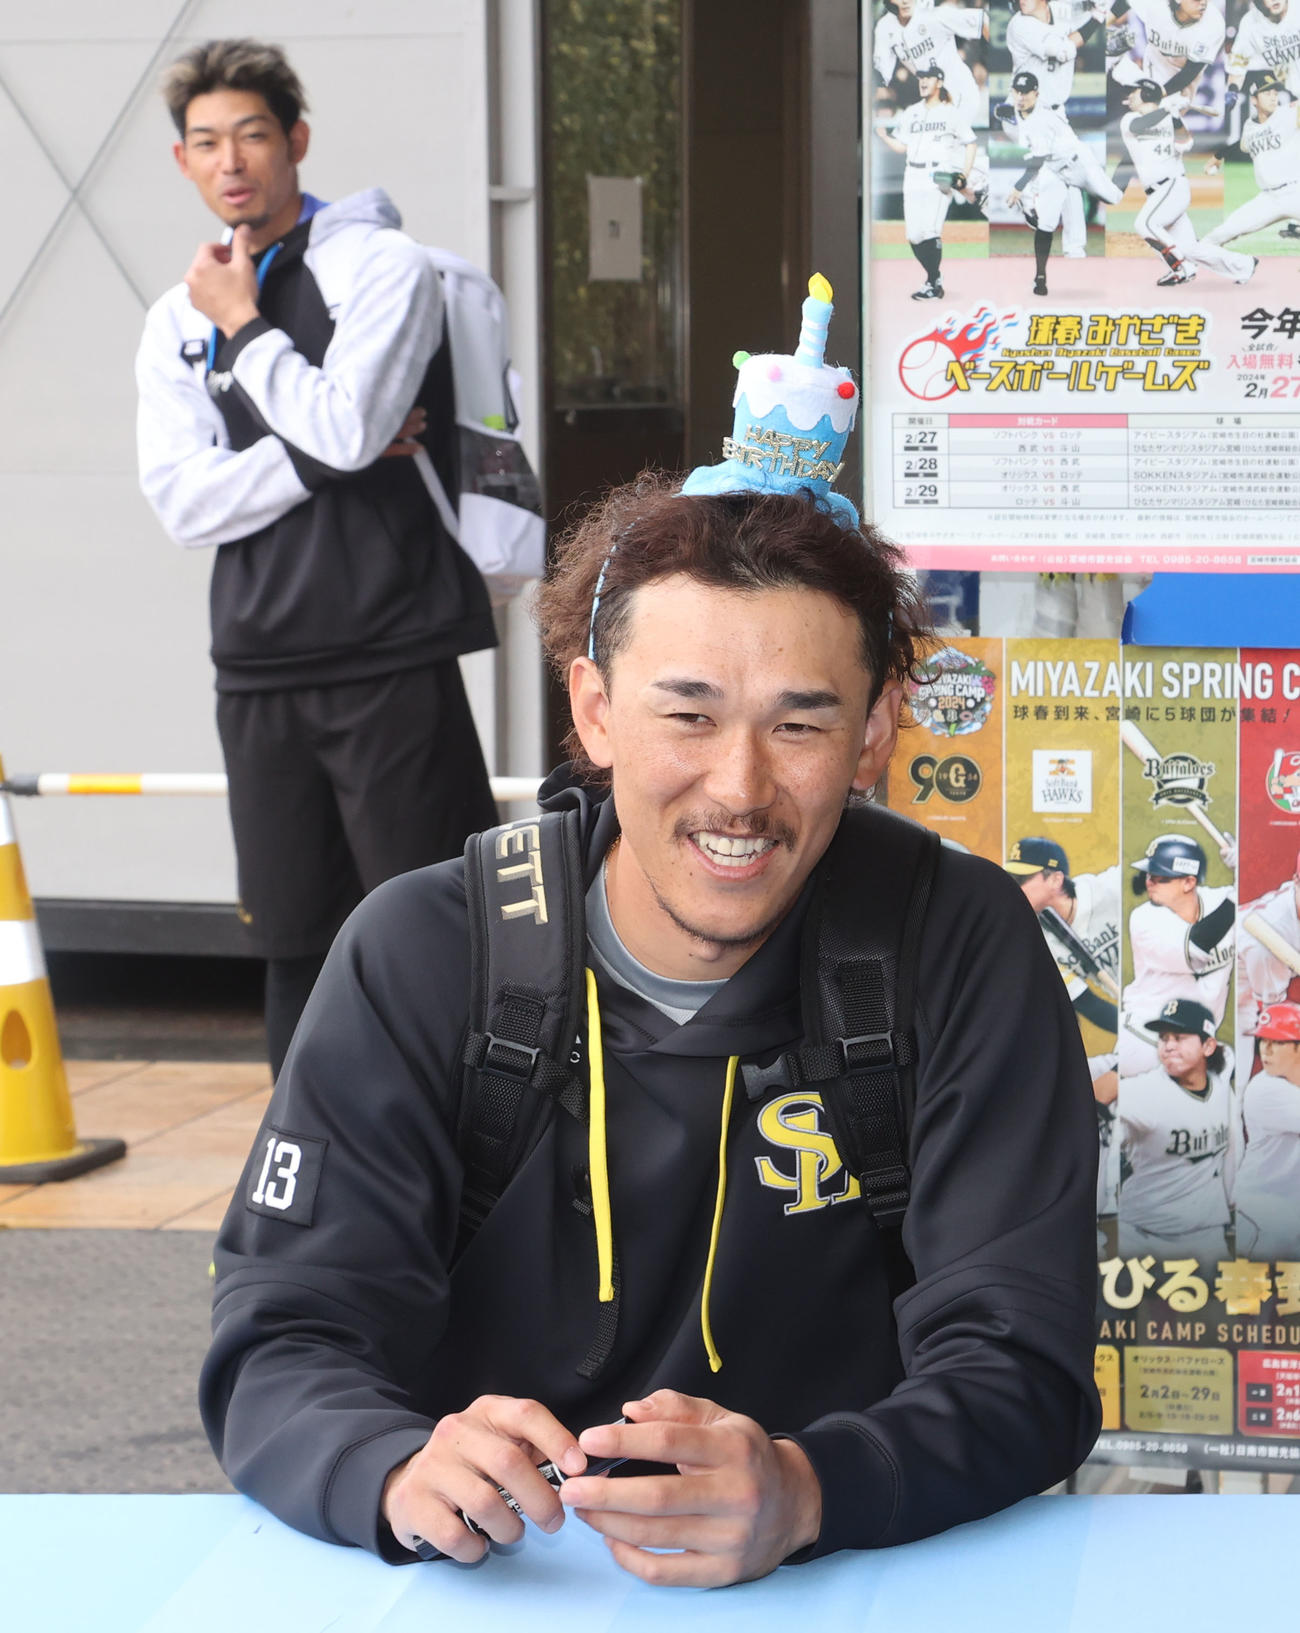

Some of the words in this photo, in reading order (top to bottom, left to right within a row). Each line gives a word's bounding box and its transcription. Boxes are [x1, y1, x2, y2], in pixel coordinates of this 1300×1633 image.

[1026, 315, 1082, 347] 球春
[1086, 315, 1206, 346] みやざき
[1240, 307, 1300, 340] 今年
[1226, 353, 1293, 370] 入場無料
[946, 360, 1211, 392] ベースボールゲームズ
[744, 424, 832, 460] HAPPY
[905, 431, 938, 444] 2/27
[1043, 432, 1055, 440] VS
[1043, 445, 1055, 453] VS
[722, 436, 846, 483] BIRTHDAY
[905, 457, 938, 471] 2/28
[1043, 459, 1055, 467] VS
[1043, 472, 1055, 480] VS
[905, 484, 938, 498] 2/29
[1043, 485, 1055, 493] VS
[1043, 499, 1055, 507] VS
[1140, 555, 1159, 565] TEL
[1010, 660, 1153, 699] MIYAZAKI
[1161, 662, 1274, 701] SPRING
[1143, 758, 1214, 778] Buffaloes
[1041, 788, 1084, 804] HAWKS
[495, 820, 549, 925] ETT
[252, 1137, 302, 1211] 13
[1099, 1319, 1136, 1340] AKI
[1146, 1320, 1207, 1342] CAMP
